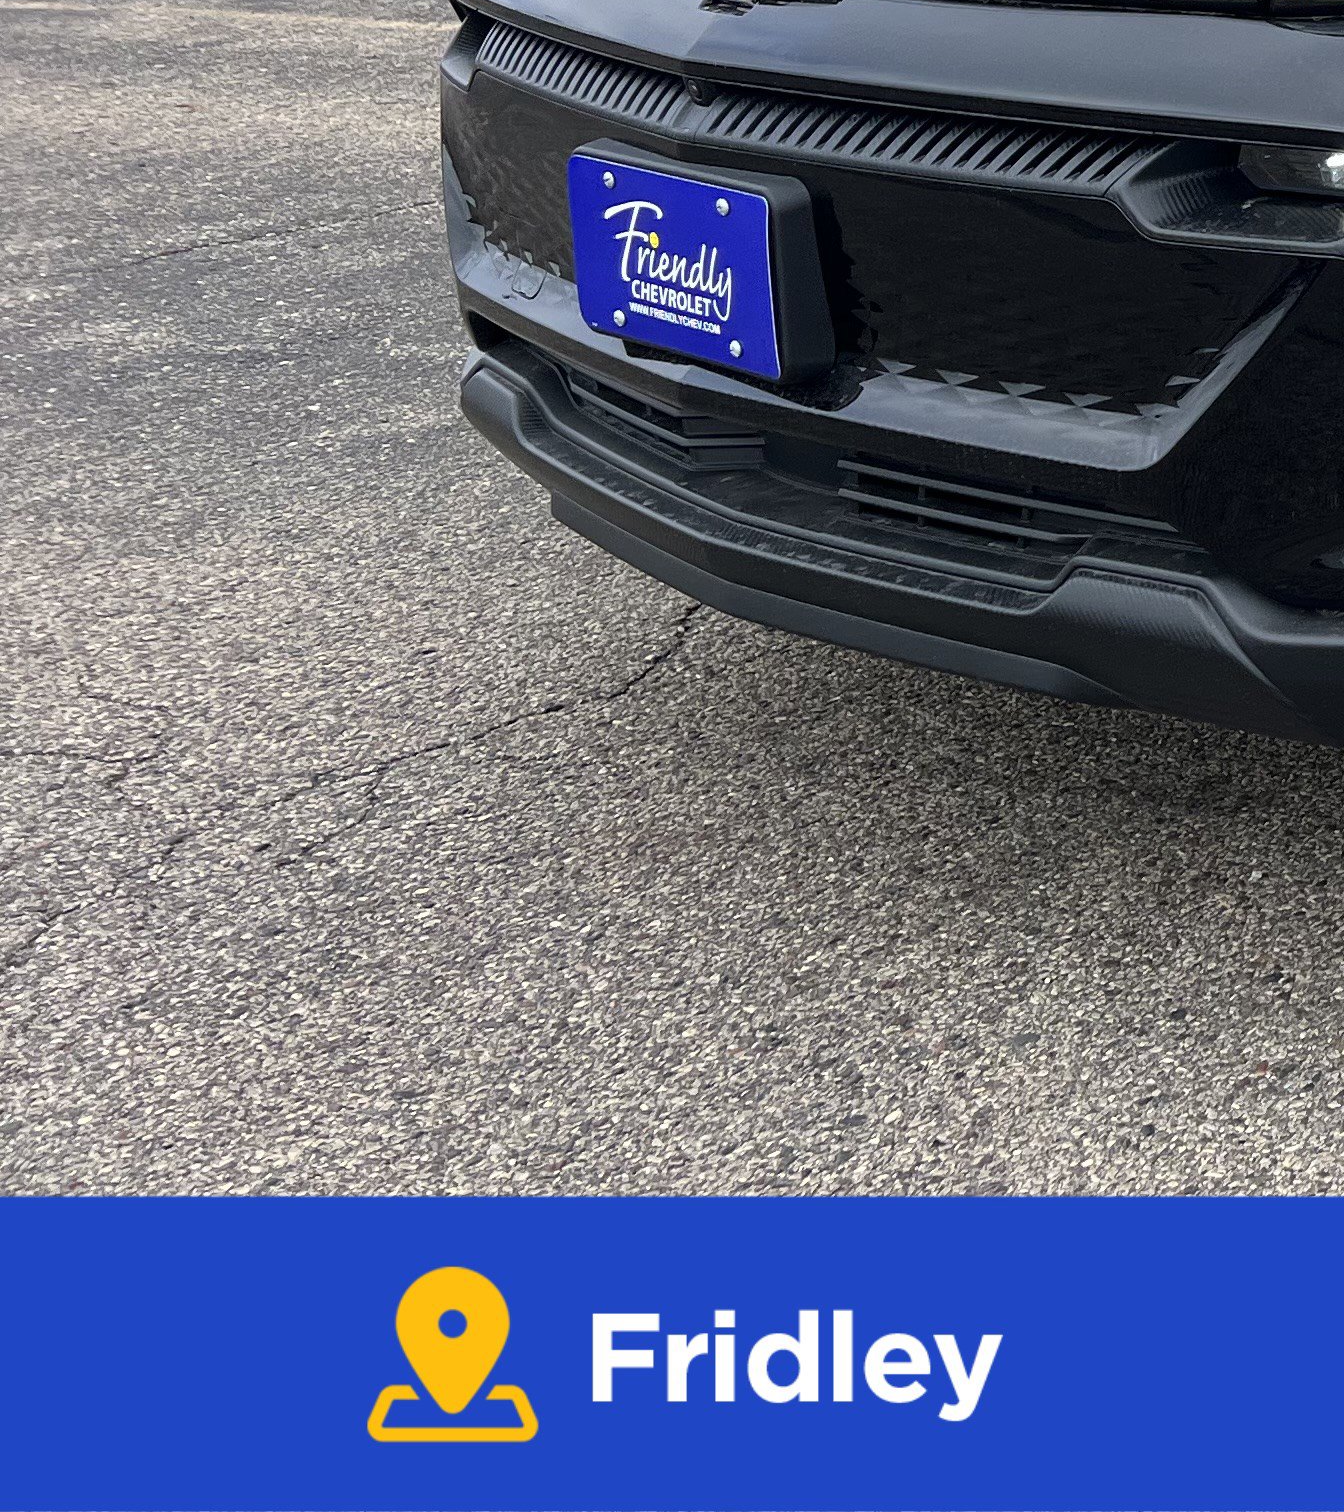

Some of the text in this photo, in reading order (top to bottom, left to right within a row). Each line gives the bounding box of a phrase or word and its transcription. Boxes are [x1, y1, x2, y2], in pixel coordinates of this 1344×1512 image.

[603, 200, 732, 322] Friendly
[631, 278, 711, 317] CHEVROLET
[628, 301, 722, 335] WWW.FRIENDLYCHEV.COM
